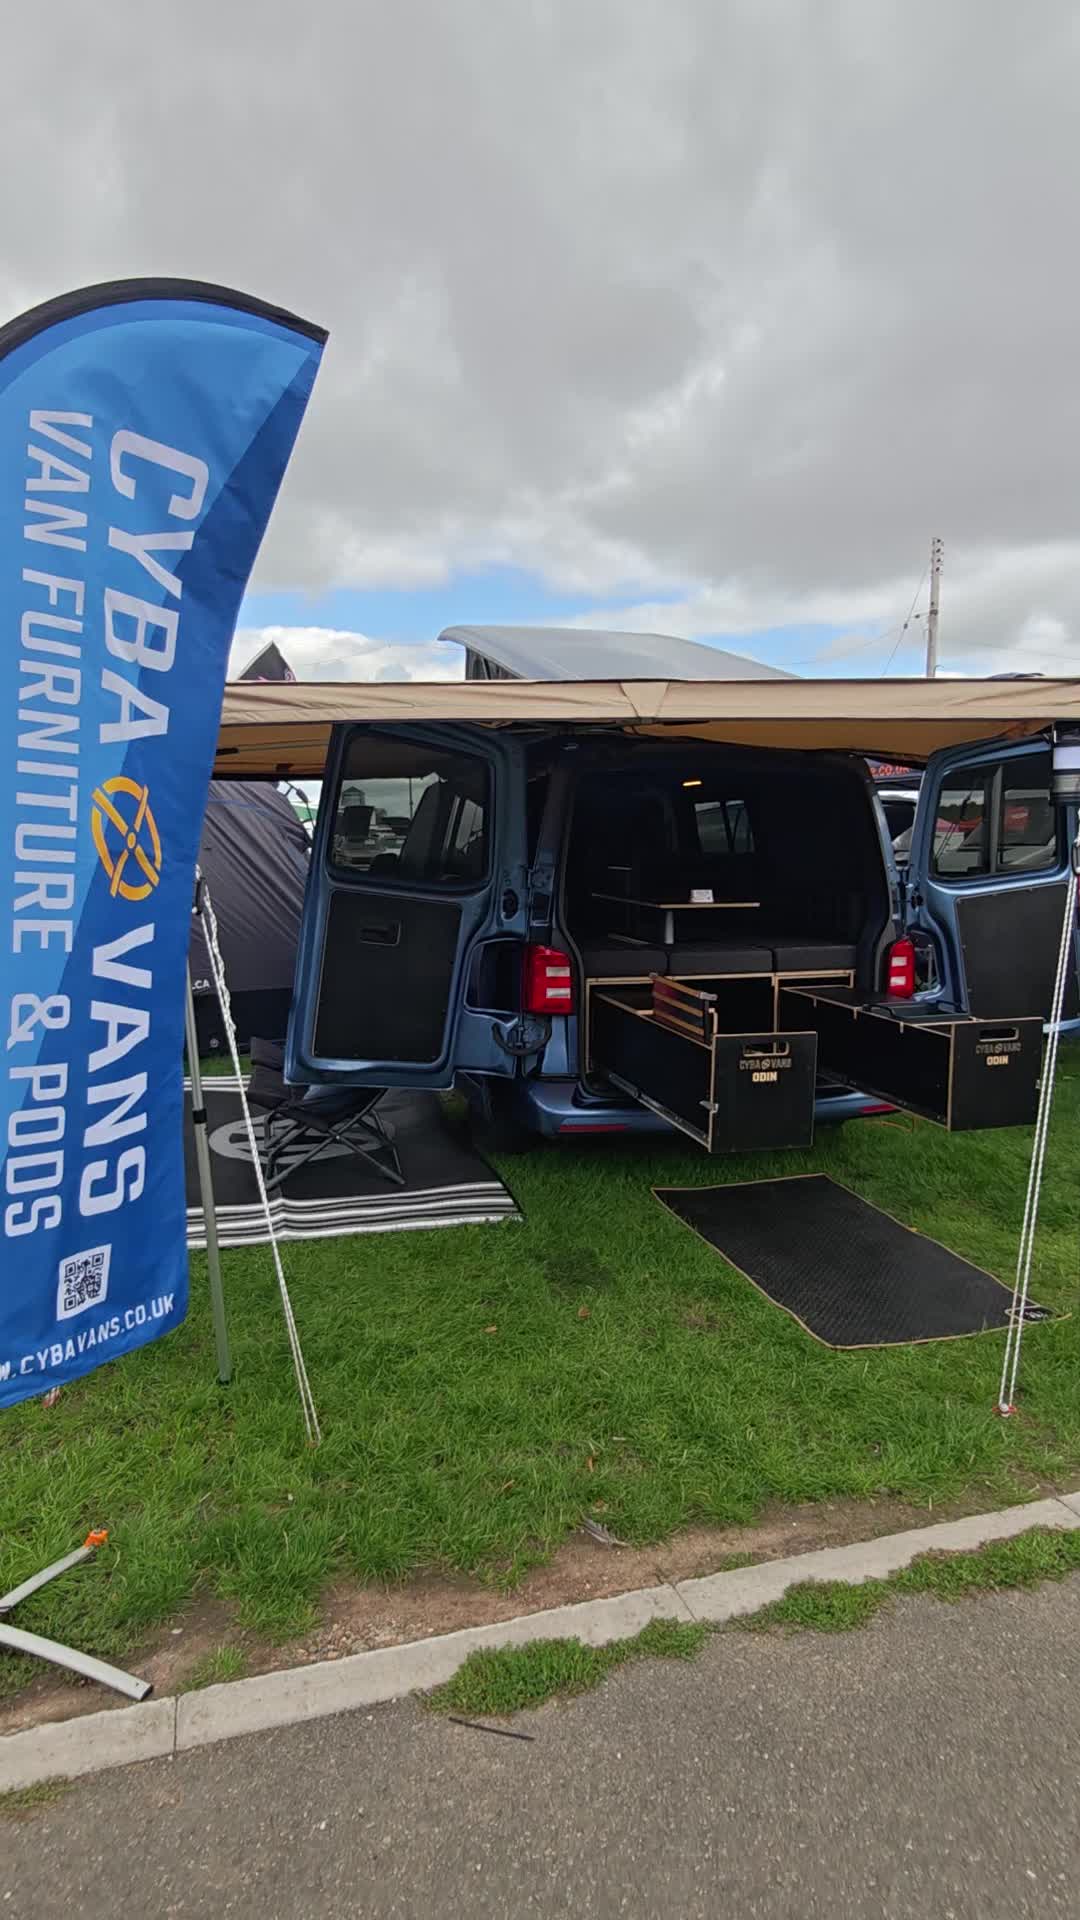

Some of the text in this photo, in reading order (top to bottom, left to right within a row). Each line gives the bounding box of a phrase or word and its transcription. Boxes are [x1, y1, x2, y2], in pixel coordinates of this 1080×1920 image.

[5, 409, 93, 1238] VAN FURNITURE & PODS
[79, 429, 210, 1217] CYBA VANS
[752, 1071, 778, 1083] ODIN
[986, 1055, 1009, 1066] ODIN
